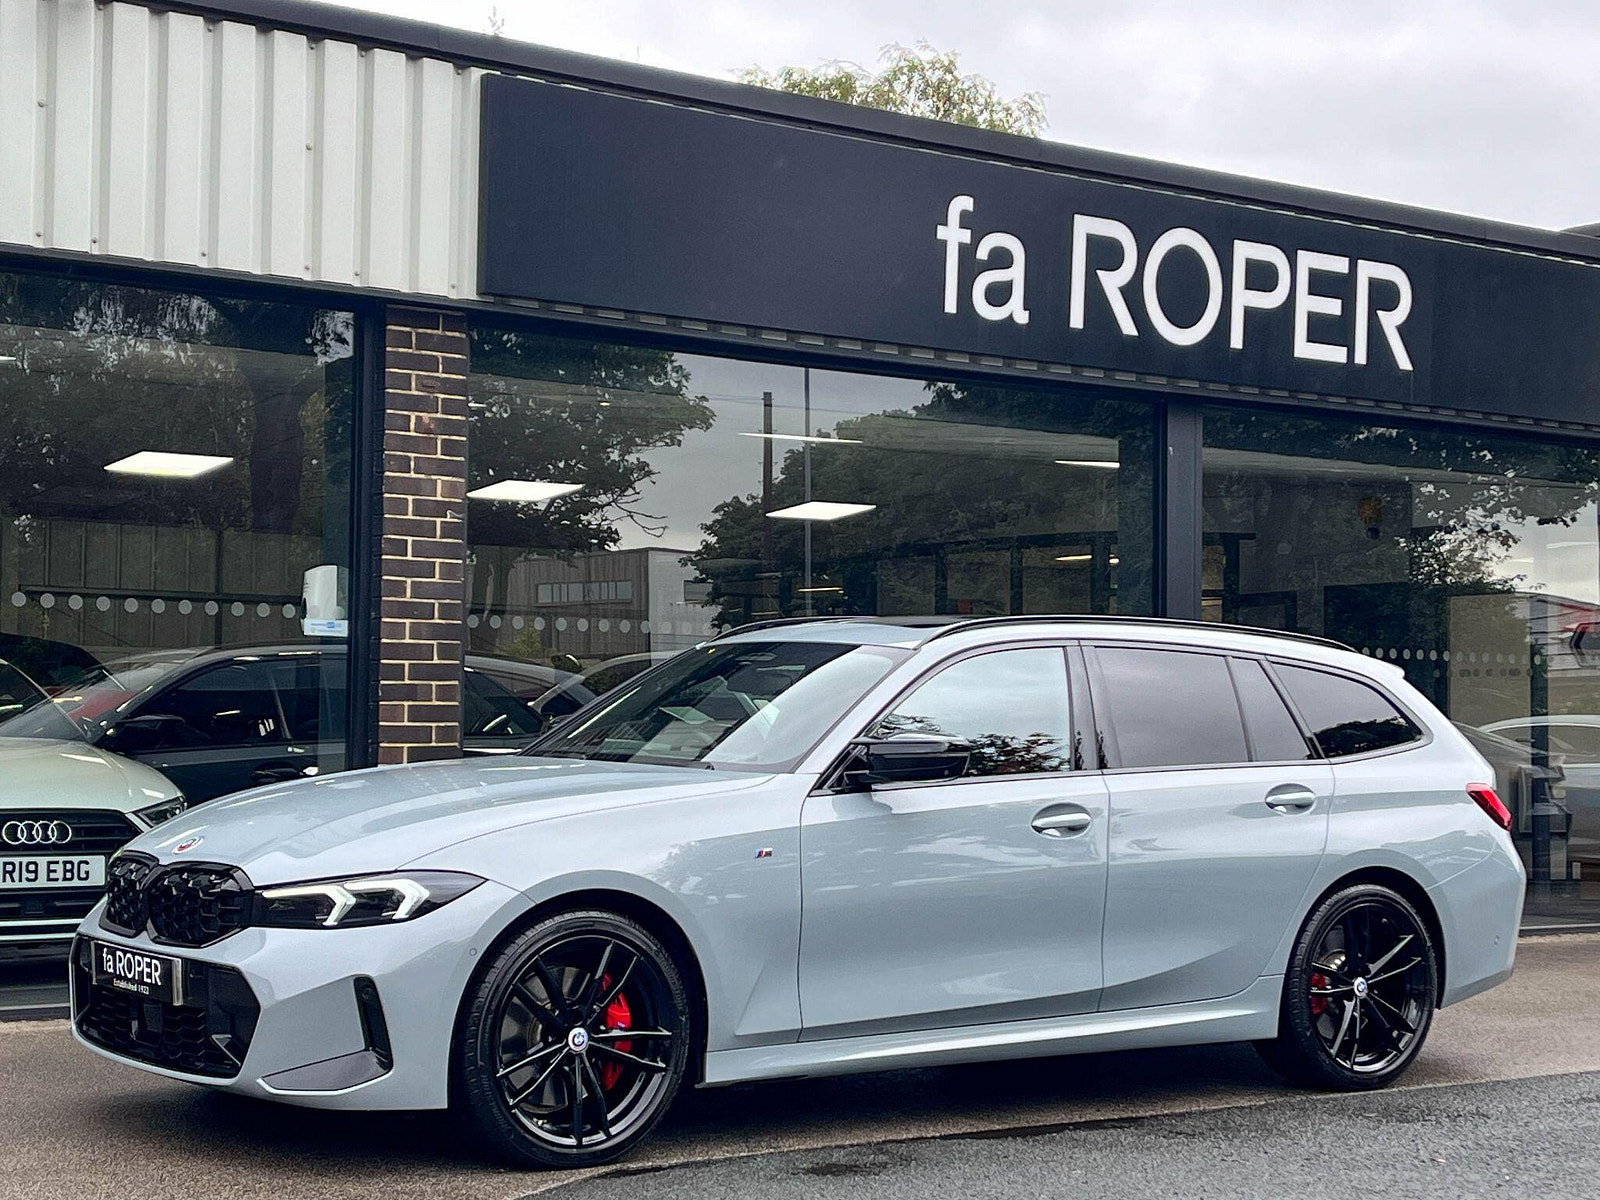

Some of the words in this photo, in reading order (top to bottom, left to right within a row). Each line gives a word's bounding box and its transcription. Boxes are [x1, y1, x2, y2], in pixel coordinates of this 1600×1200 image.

[935, 194, 1030, 325] fa
[1068, 212, 1414, 371] ROPER
[2, 860, 39, 883] R19
[46, 860, 90, 882] EBG
[102, 947, 114, 973] fa
[115, 950, 162, 986] ROPER
